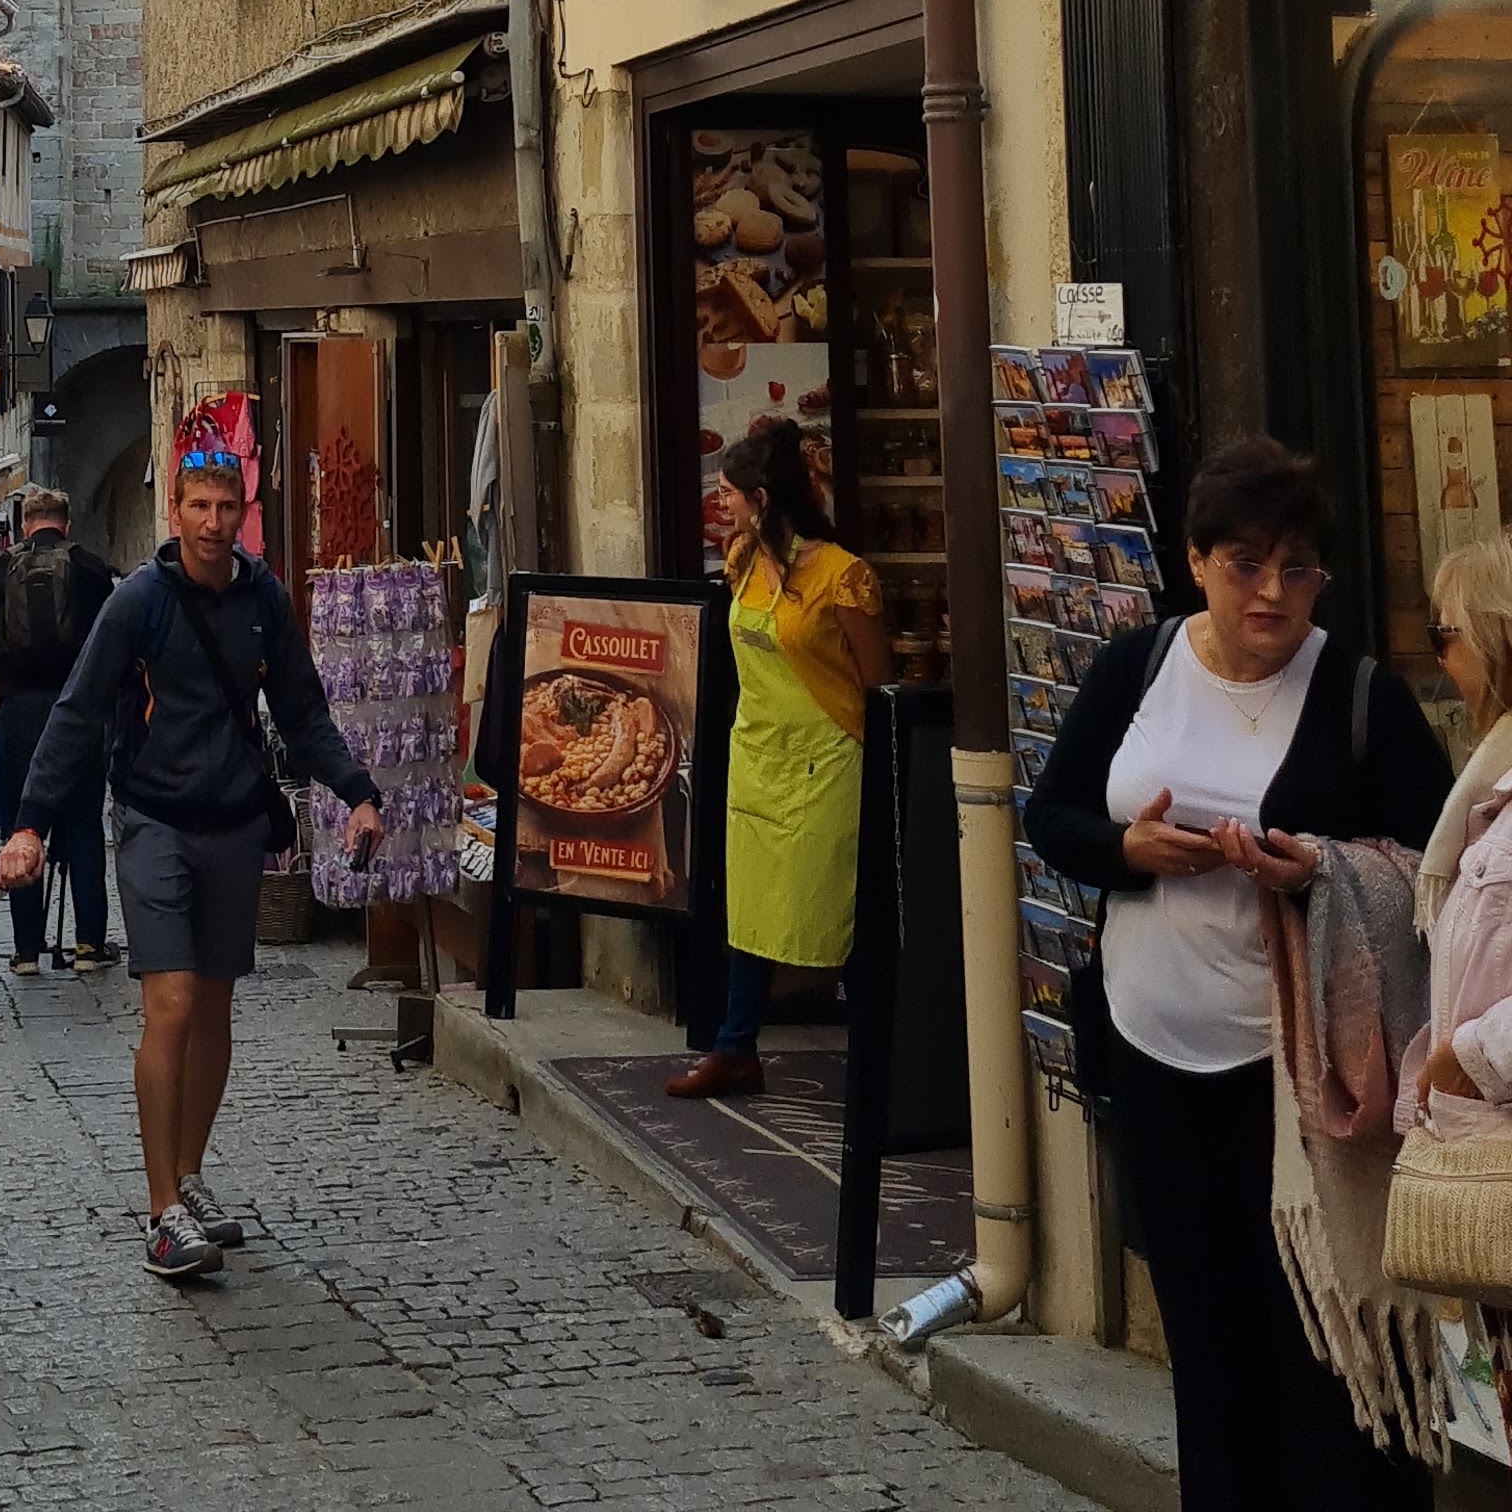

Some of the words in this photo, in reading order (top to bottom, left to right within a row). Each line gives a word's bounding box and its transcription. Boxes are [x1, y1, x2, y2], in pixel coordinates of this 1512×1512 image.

[1058, 285, 1106, 305] Caisse
[569, 627, 660, 660] CASSOULET
[558, 841, 575, 860] EN
[580, 841, 626, 867] VENTE
[630, 850, 649, 870] ICI
